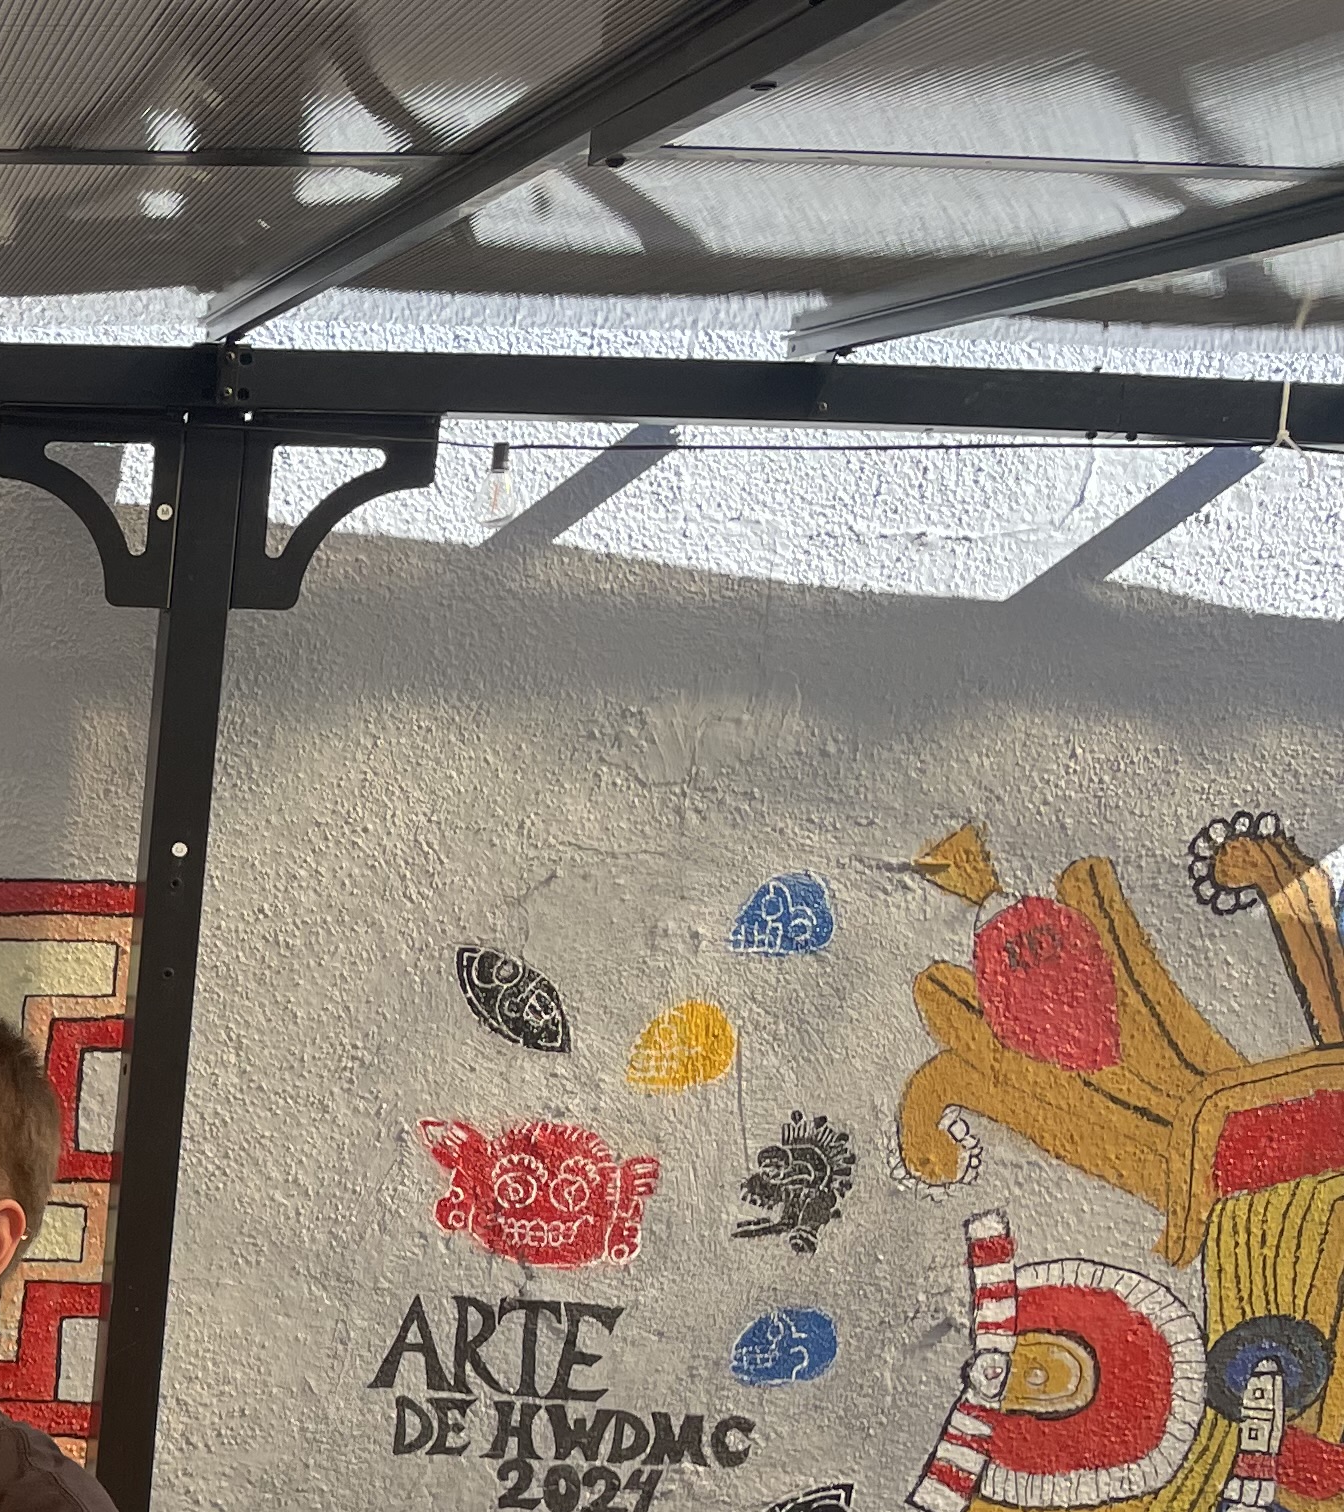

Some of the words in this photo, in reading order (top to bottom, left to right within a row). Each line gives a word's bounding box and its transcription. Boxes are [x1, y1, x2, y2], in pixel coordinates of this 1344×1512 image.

[367, 1294, 625, 1400] ARTE
[392, 1396, 479, 1456] DE
[479, 1400, 757, 1468] HWDMC
